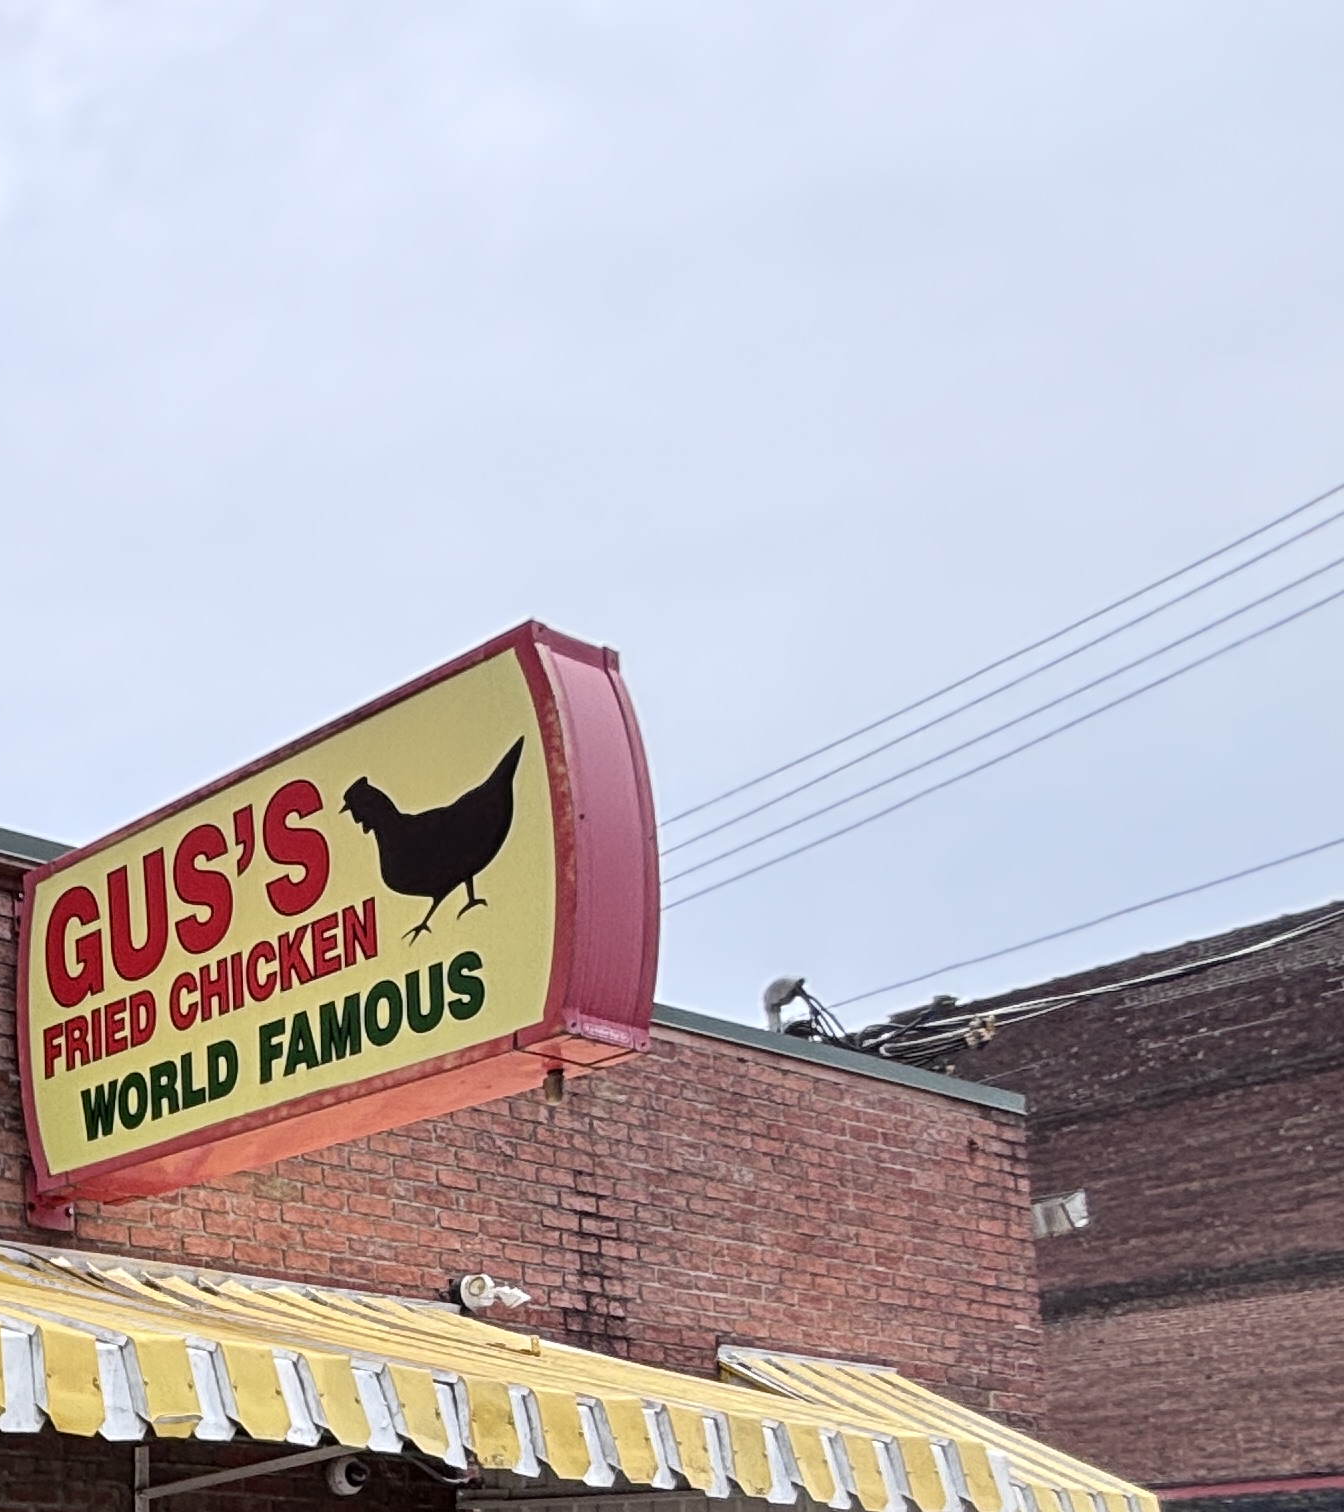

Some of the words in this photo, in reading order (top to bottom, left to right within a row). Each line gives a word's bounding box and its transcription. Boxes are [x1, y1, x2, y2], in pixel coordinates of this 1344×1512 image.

[43, 989, 156, 1080] FRIED
[169, 897, 379, 1032] CHICKEN
[44, 779, 330, 1008] GUS'S
[81, 1039, 239, 1141] WORLD
[258, 951, 485, 1084] FAMOUS
